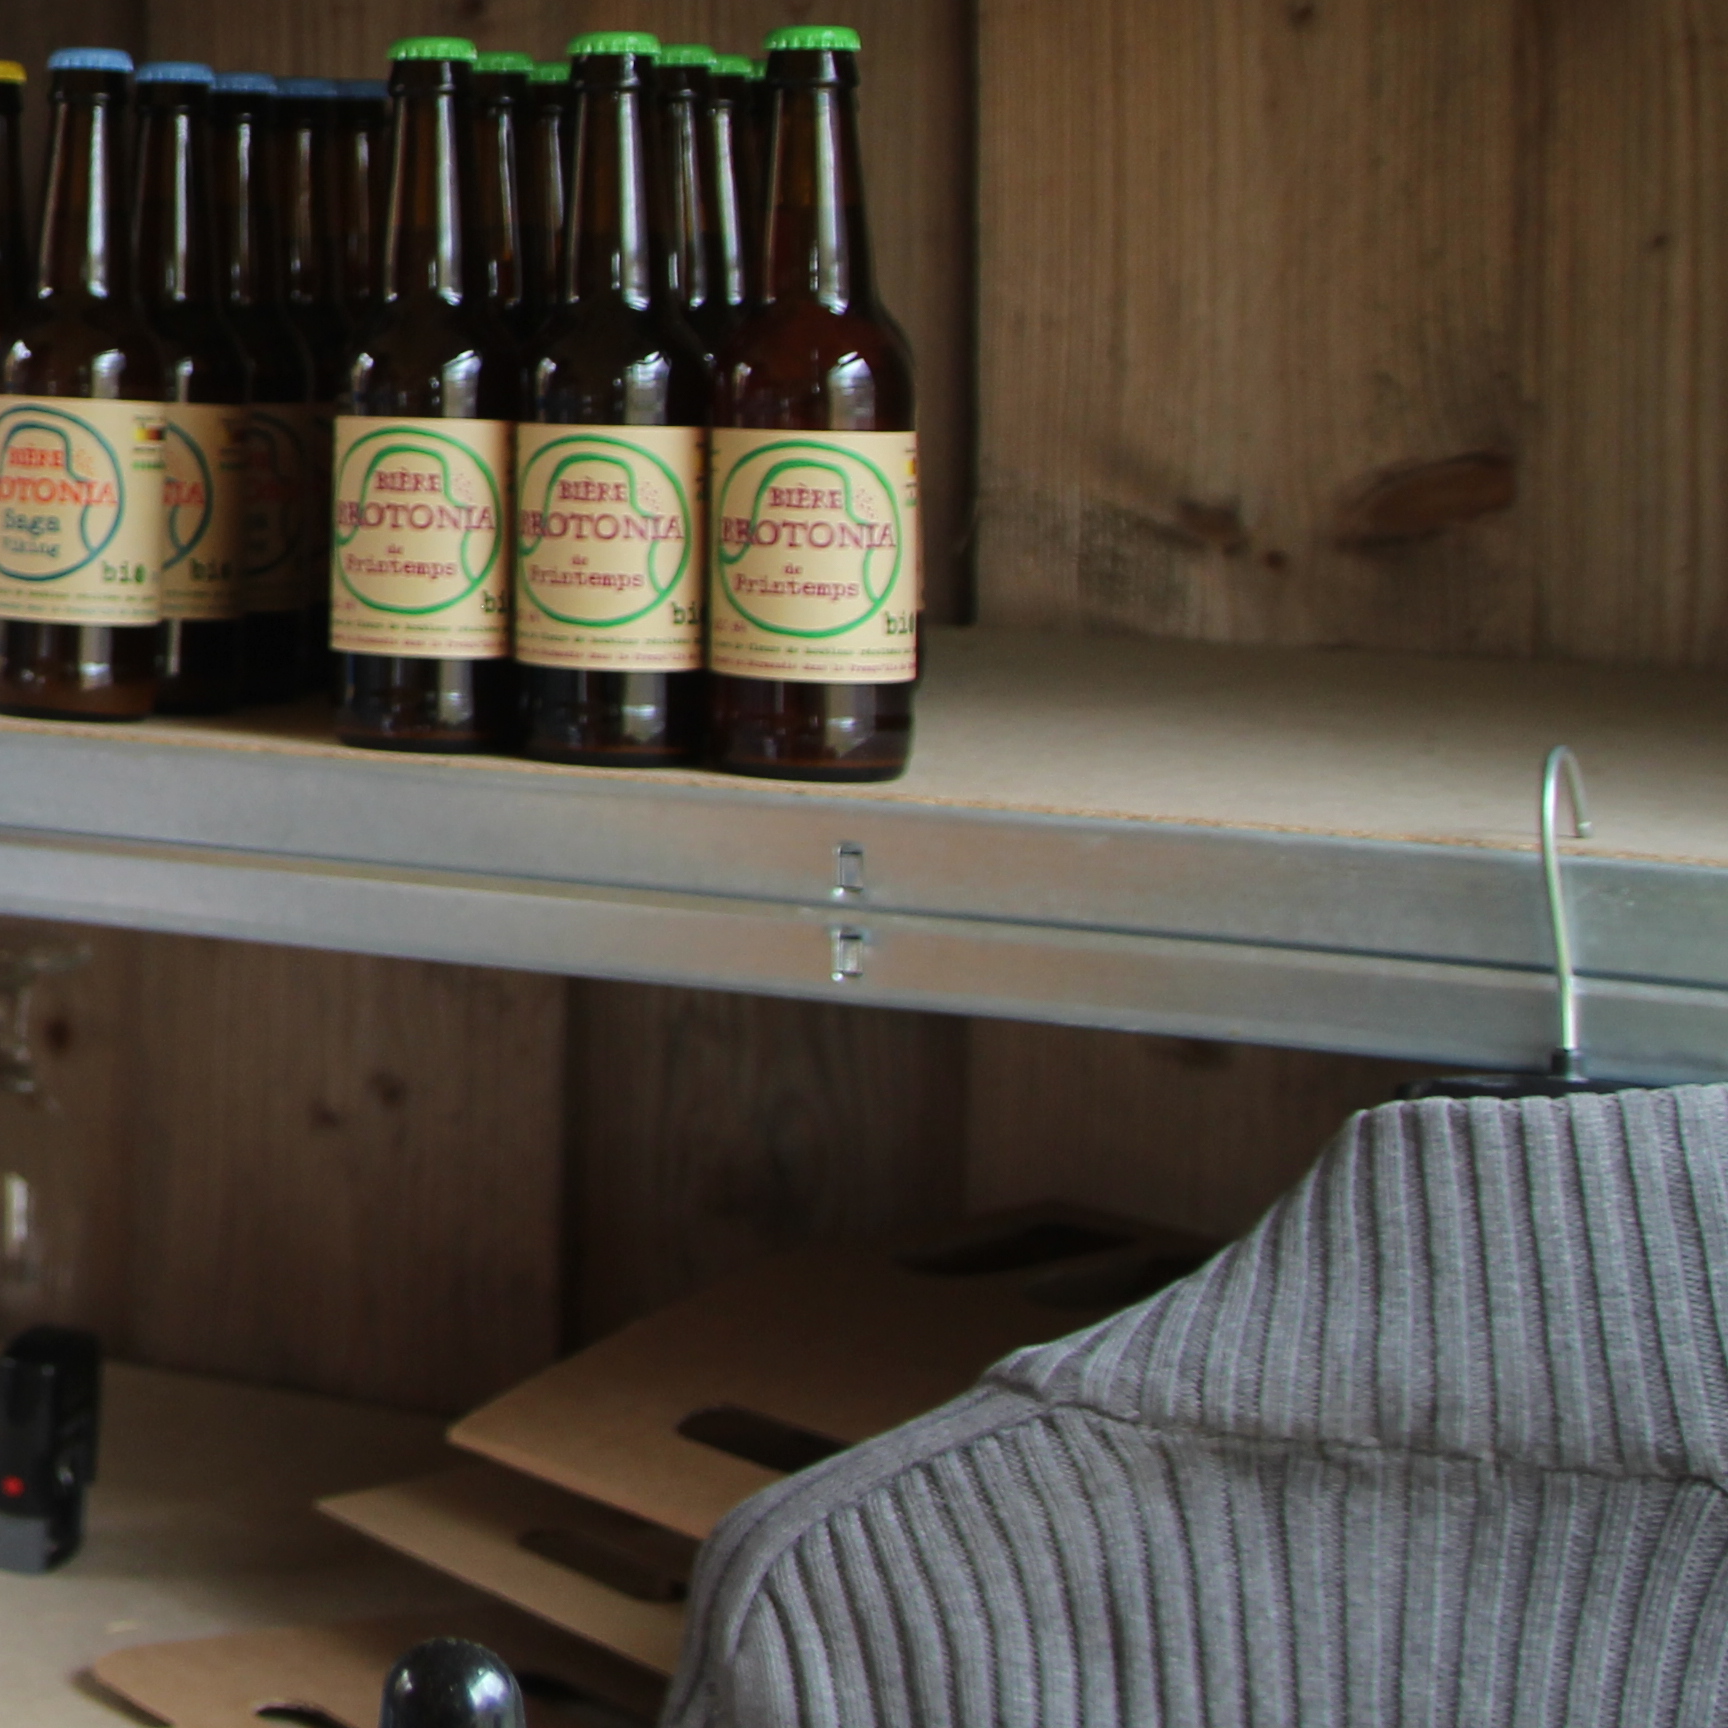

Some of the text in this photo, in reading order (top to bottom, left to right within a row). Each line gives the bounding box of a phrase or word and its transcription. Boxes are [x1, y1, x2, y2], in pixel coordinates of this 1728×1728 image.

[3, 507, 61, 536] Saga
[346, 553, 457, 580] Printemps
[529, 564, 644, 591] Printemps
[733, 573, 860, 602] Printemps
